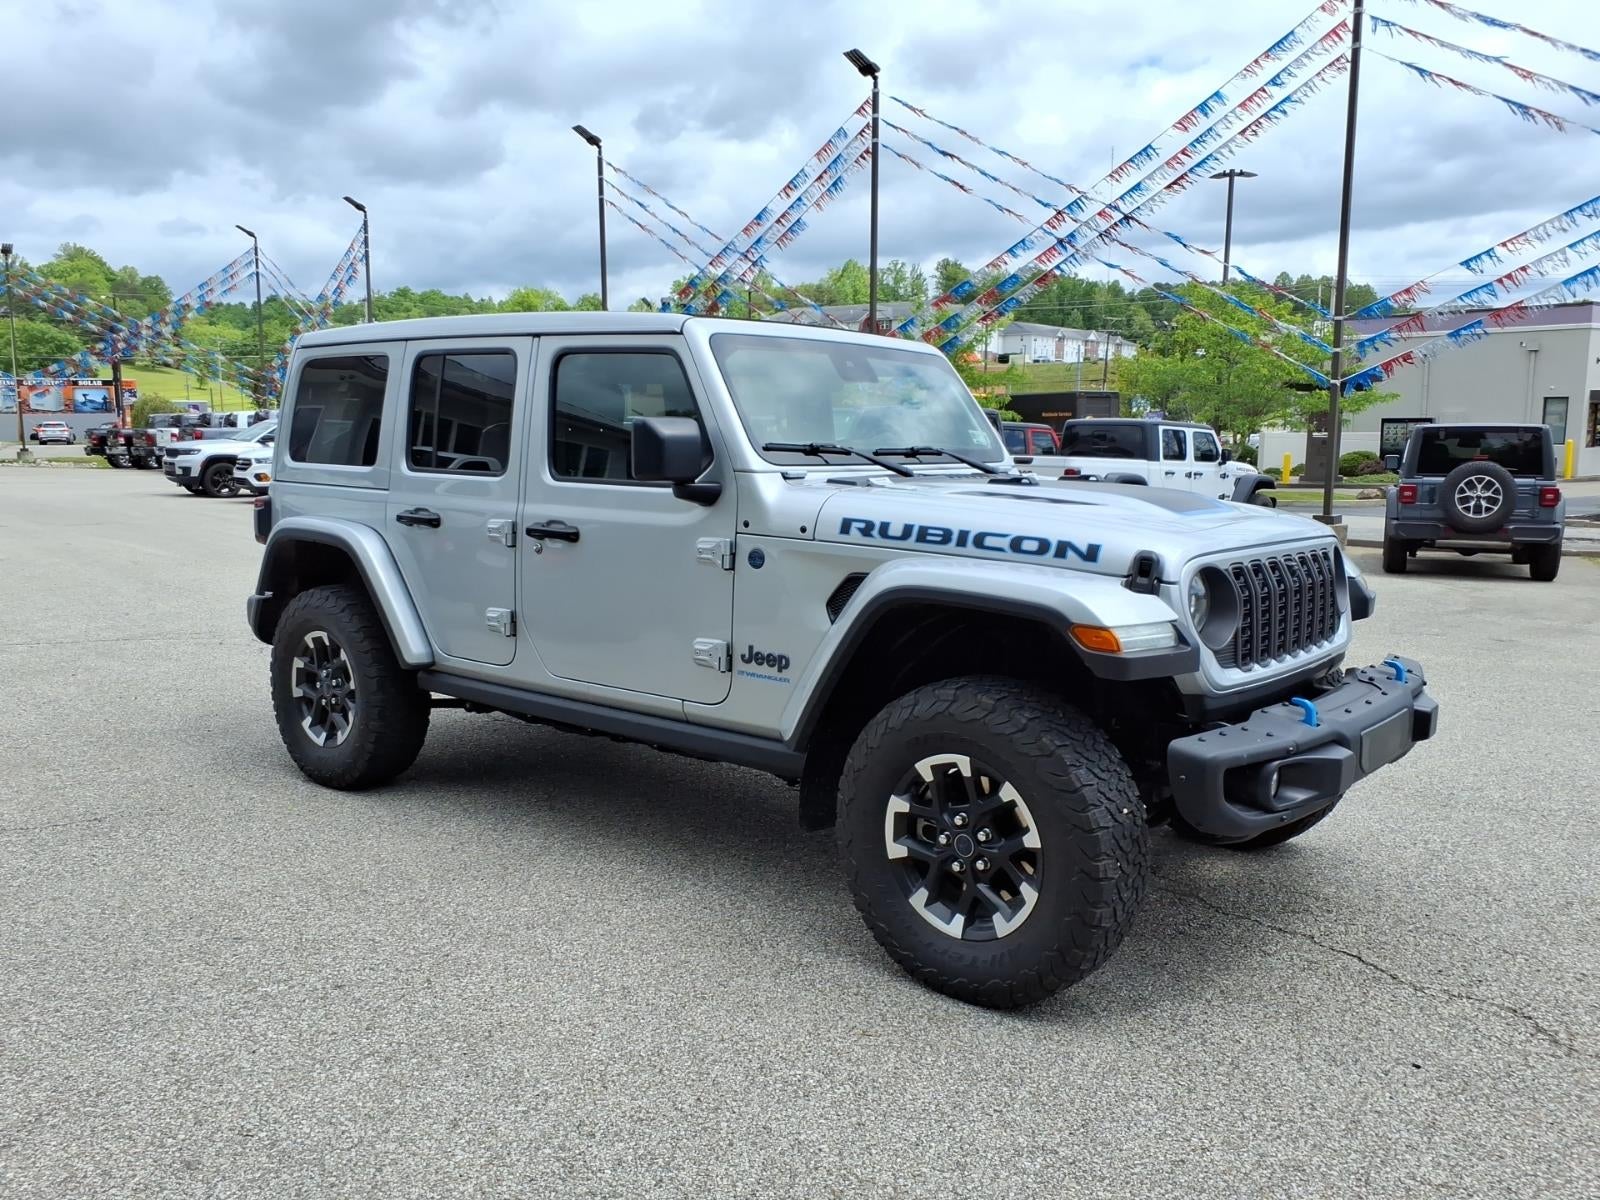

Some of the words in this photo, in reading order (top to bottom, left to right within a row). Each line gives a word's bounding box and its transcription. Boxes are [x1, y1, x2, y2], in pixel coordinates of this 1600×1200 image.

[839, 516, 1103, 563] RUBICON
[740, 644, 791, 673] Jeep
[745, 671, 791, 683] WRANGLER
